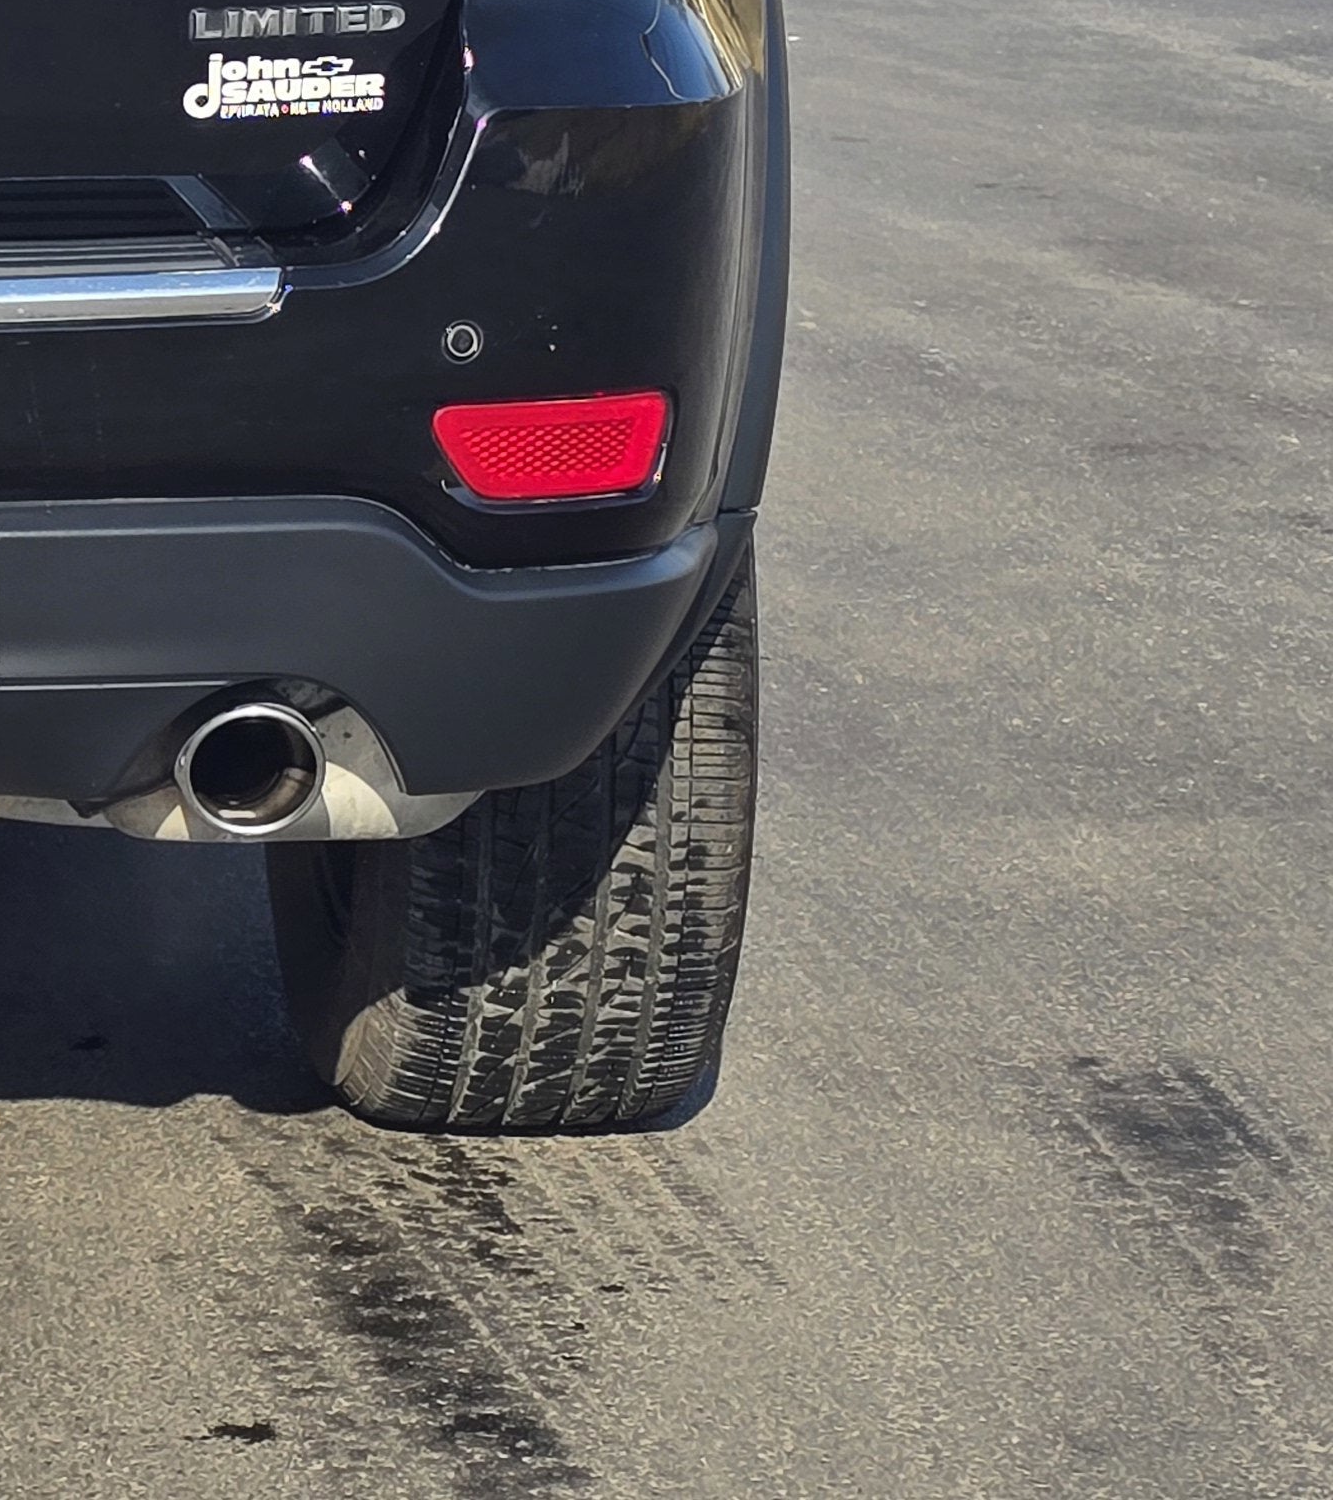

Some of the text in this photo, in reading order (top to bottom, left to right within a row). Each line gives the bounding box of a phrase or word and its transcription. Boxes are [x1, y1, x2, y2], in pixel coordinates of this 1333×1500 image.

[189, 2, 406, 41] LIMITED
[221, 73, 385, 104] SAUDER
[322, 97, 384, 115] HOLLAND
